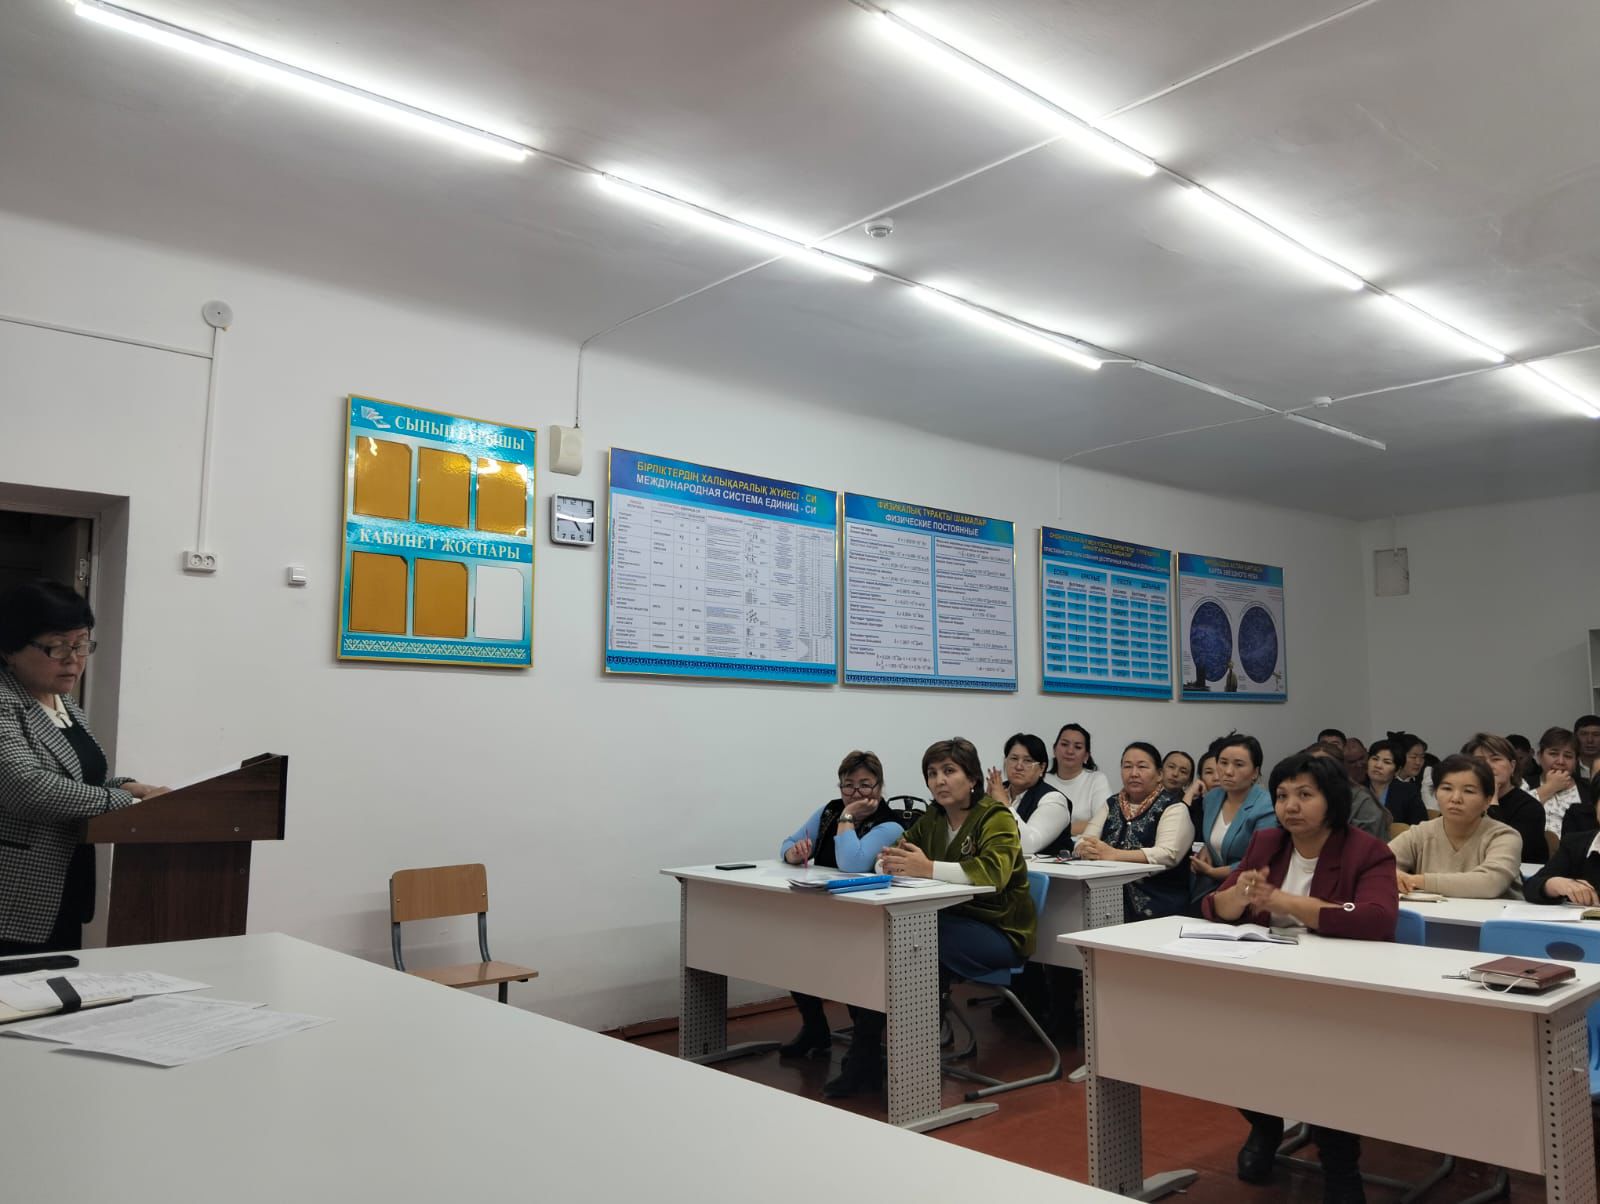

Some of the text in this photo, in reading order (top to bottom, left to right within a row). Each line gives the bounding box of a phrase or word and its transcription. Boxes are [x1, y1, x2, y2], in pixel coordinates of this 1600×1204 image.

[636, 474, 721, 498] МЕЖДУНАРОДНАЯ
[722, 489, 763, 505] СИСТЕМА
[765, 497, 799, 513] ЕДИНИЦ
[805, 505, 817, 515] СИ
[637, 461, 699, 483] БІРЛІКТЕРДІҢ
[701, 474, 768, 496] ХАЛЫҚАРАЛЫҚ
[805, 494, 817, 503] СИ
[877, 502, 922, 517] ФИЗИКАЛЫҚ
[954, 513, 988, 527] ШАМАЛАР
[885, 514, 980, 537] ФИЗИЧЕСКИЕ ПОСТОЯННЫЕ
[359, 528, 520, 560] КАБИНЕТ ЖОСПАРЫ
